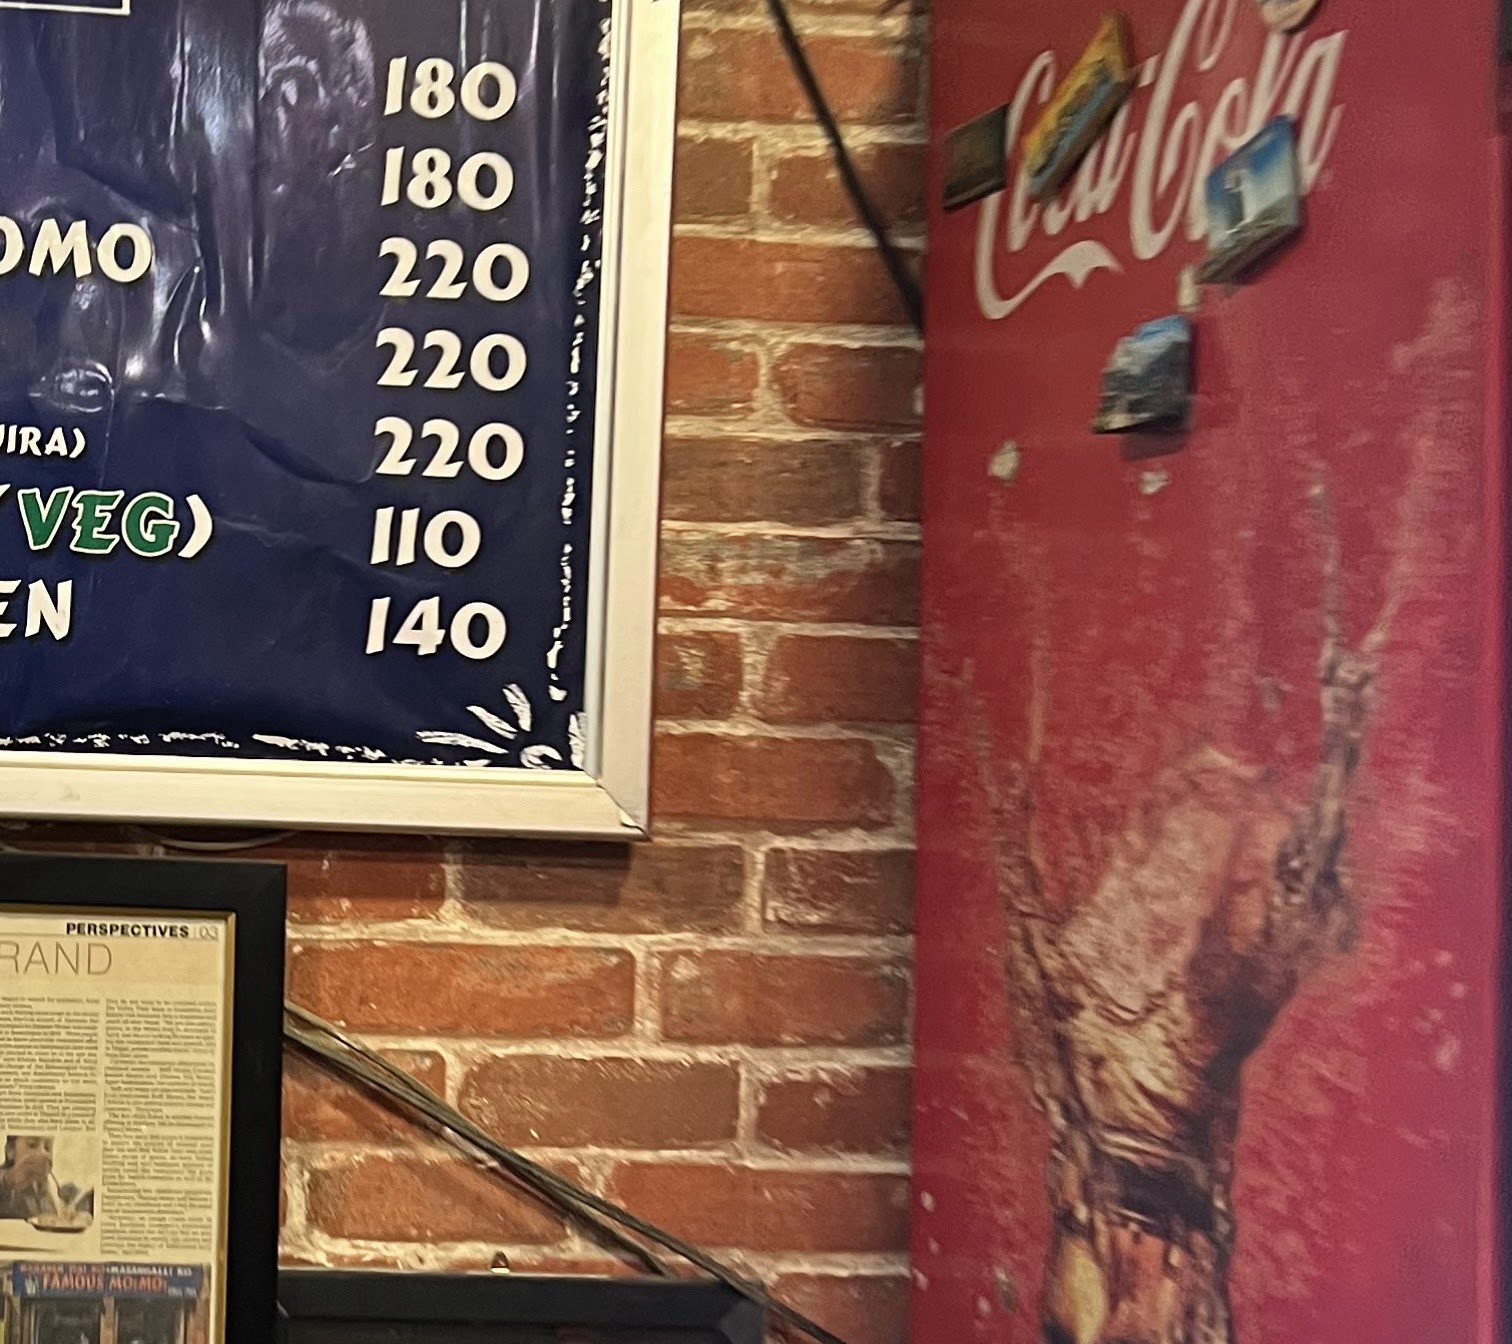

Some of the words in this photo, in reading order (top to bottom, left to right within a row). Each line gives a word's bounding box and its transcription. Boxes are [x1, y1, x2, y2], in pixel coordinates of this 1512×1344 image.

[383, 55, 517, 121] 180
[379, 145, 515, 212] 180
[378, 236, 530, 302] 220
[374, 327, 528, 392] 220
[373, 416, 525, 481] 220
[369, 505, 482, 569] 110
[365, 595, 507, 660] 140
[66, 922, 189, 939] PERSPECTIVES
